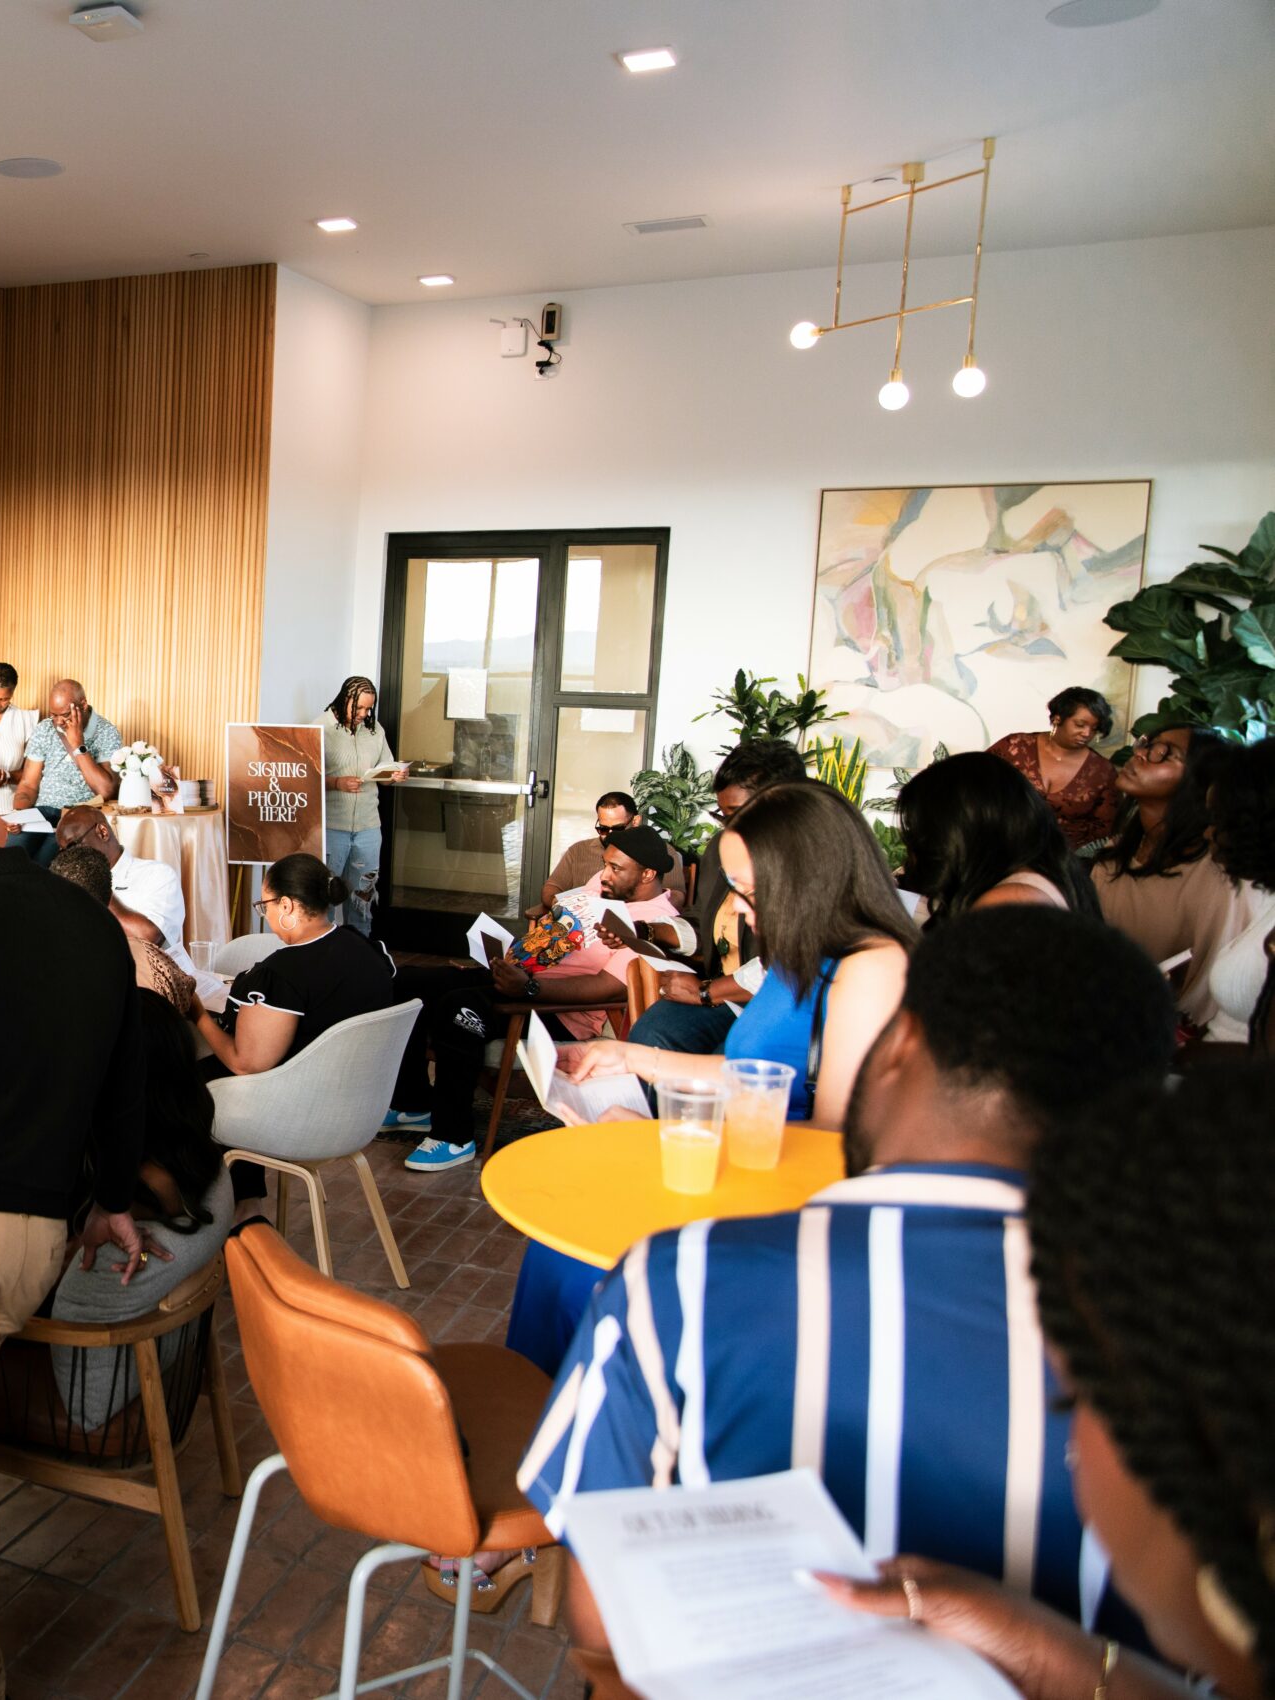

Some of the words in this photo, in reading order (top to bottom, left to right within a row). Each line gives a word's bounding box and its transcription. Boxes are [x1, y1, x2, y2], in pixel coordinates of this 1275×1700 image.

[247, 761, 308, 778] SIGNING
[269, 777, 281, 792] &
[248, 791, 308, 808] PHOTOS
[259, 806, 297, 823] HERE
